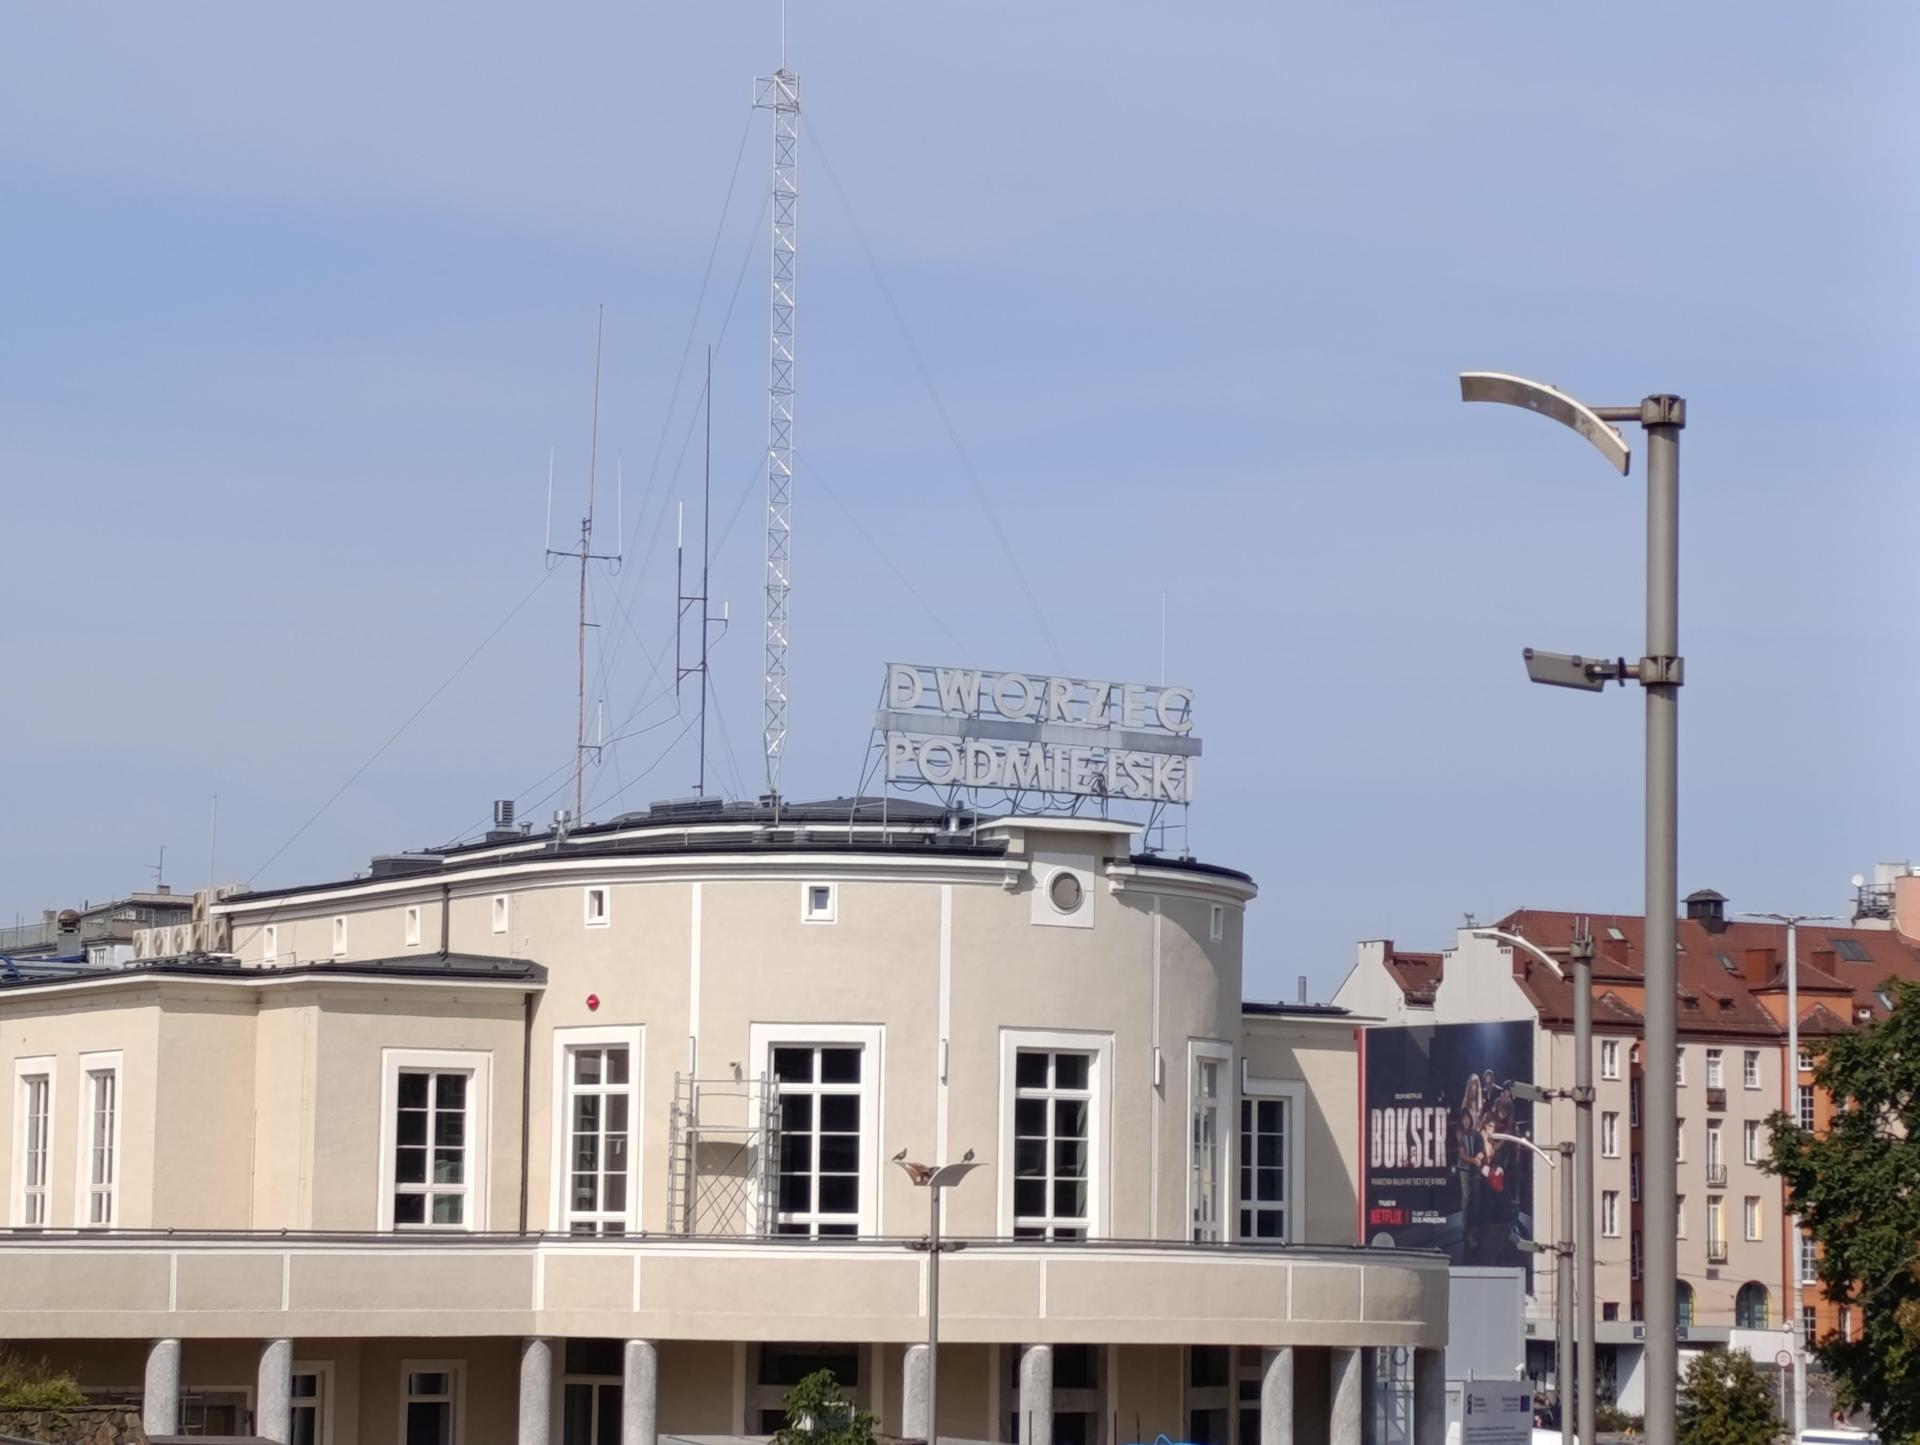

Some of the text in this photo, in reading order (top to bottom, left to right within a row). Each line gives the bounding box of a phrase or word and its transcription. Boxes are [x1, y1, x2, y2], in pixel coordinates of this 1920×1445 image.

[888, 665, 1195, 733] DWORZEC
[887, 734, 1195, 802] PODMIEJSKI
[1371, 1107, 1446, 1168] BOKSER
[1371, 1209, 1403, 1224] NETFLIX
